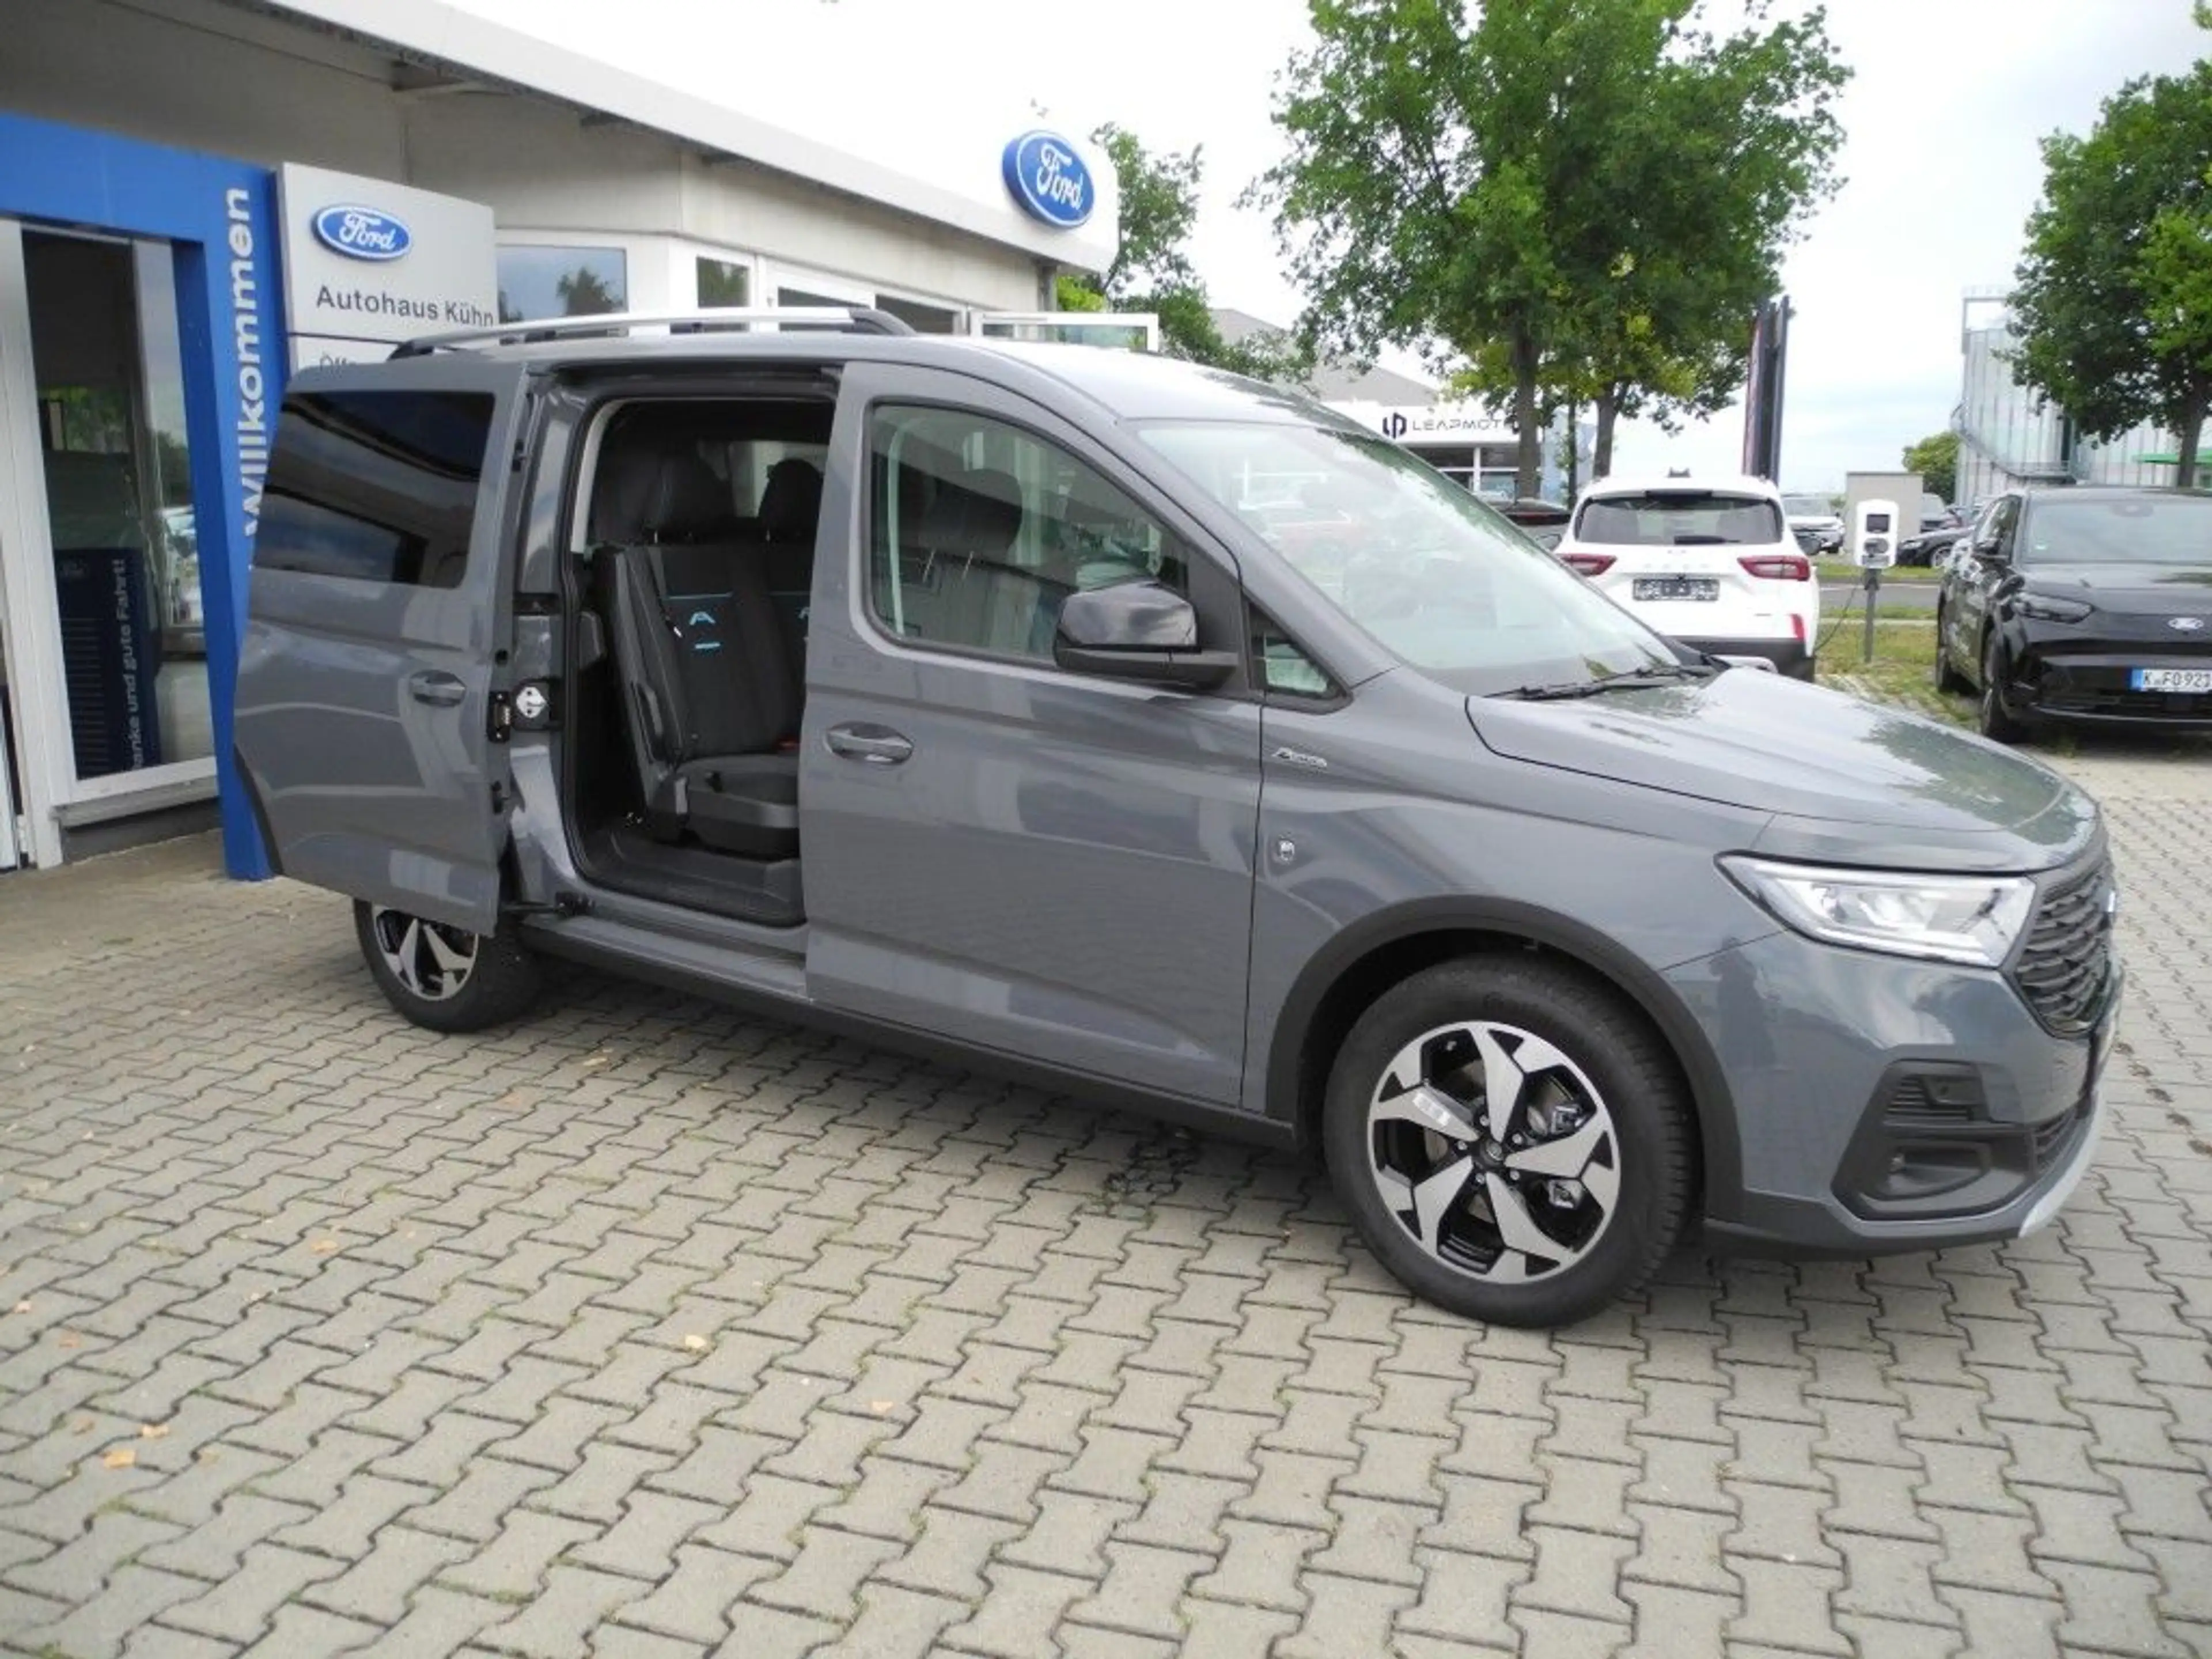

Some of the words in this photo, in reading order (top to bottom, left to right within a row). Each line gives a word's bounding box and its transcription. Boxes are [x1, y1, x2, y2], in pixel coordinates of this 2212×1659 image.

[1037, 142, 1084, 210] Ford
[339, 211, 397, 250] Ford
[316, 285, 439, 319] Autohaus
[445, 300, 494, 327] Kühn
[1412, 418, 1502, 431] LEAPMOT
[120, 624, 137, 671] gute
[123, 673, 139, 713] und
[128, 715, 144, 770] anke
